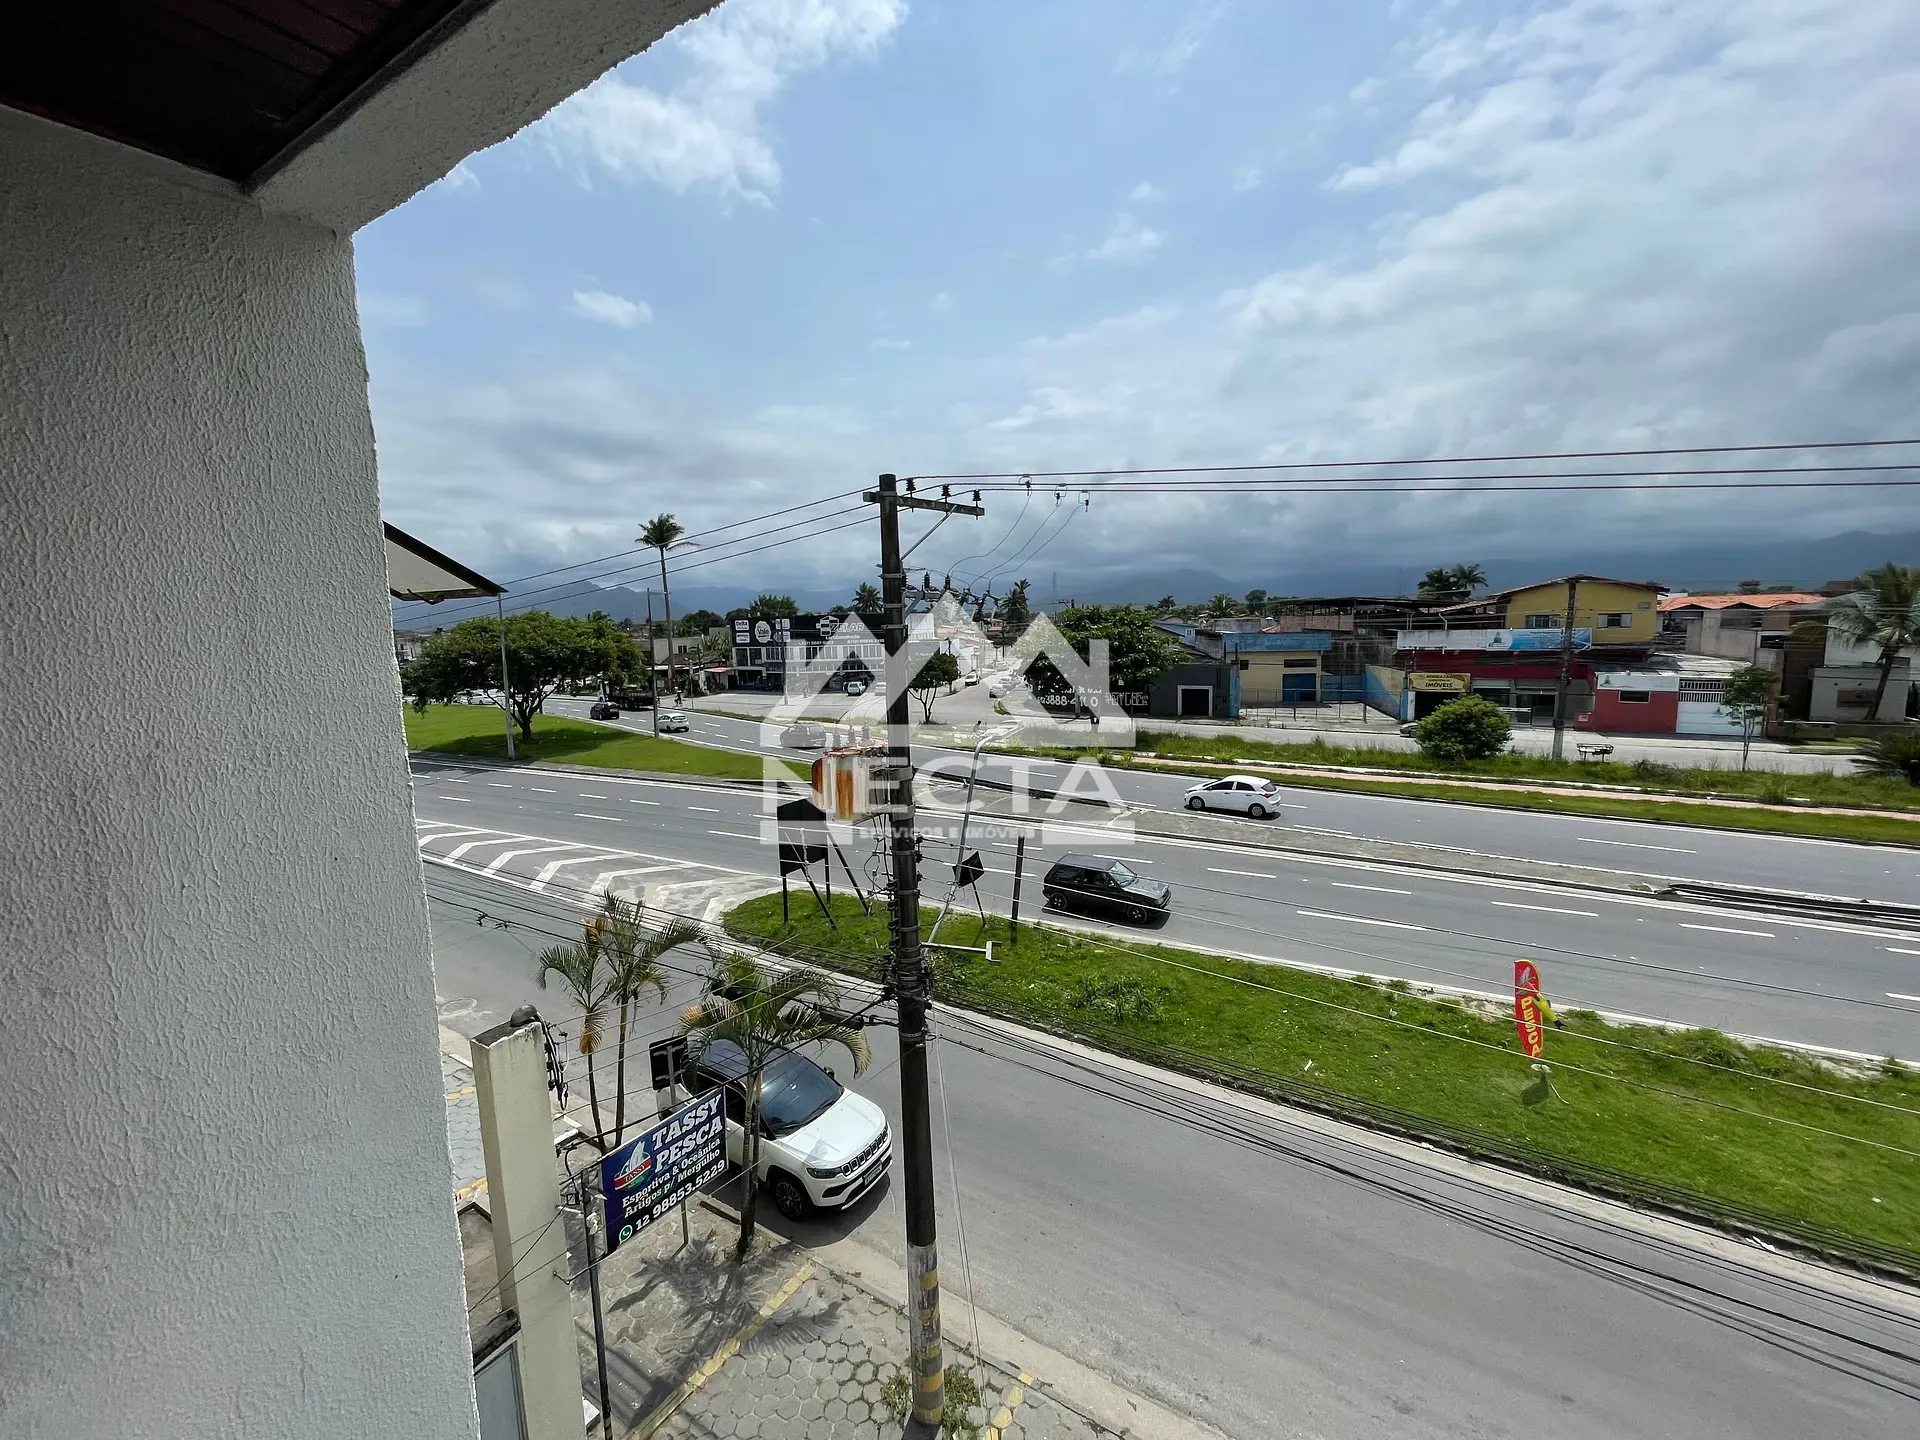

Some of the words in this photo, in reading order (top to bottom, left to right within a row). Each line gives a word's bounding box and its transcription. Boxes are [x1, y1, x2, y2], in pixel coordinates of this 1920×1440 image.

[1425, 680, 1453, 688] IMÓVEIS
[1520, 995, 1541, 1058] PESCA
[652, 1093, 722, 1151] TASSY
[654, 1115, 723, 1174] PESCA
[621, 1170, 671, 1209] Esportiva
[672, 1165, 680, 1176] &
[681, 1137, 721, 1171] Oceânica
[623, 1164, 646, 1183] TASSY
[623, 1188, 663, 1219] Artigos
[677, 1148, 720, 1185] Mergulho
[635, 1213, 651, 1231] 12
[652, 1159, 725, 1220] 98853.5229
